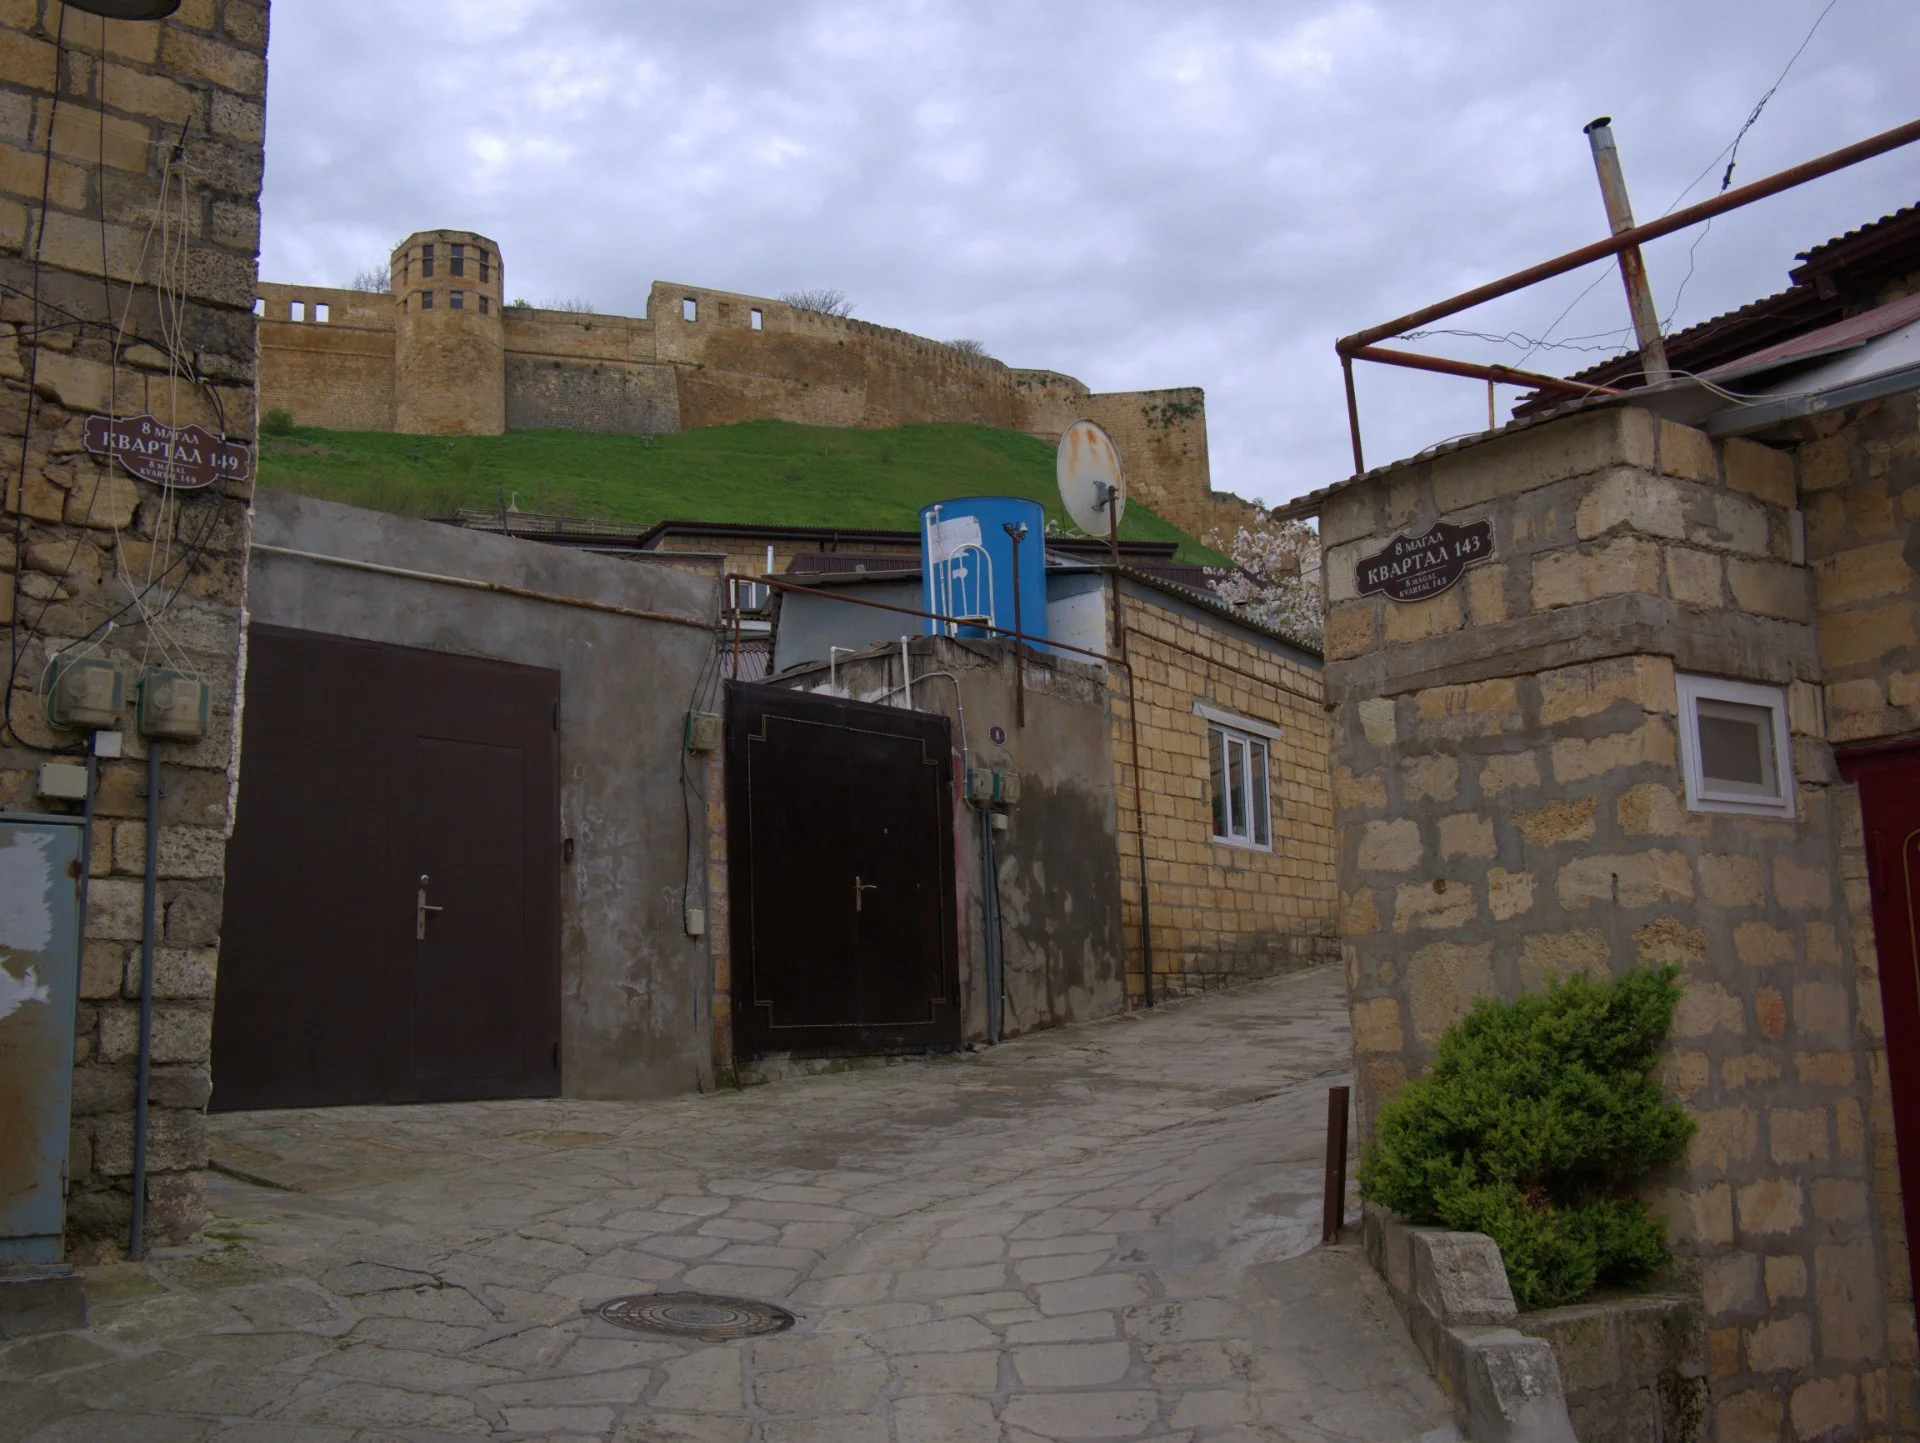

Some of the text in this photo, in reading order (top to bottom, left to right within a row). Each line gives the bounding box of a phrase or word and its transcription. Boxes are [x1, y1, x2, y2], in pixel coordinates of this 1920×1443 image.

[142, 422, 199, 444] 8 МАГАЛ
[103, 431, 239, 471] КВАРТАЛ 149
[1395, 532, 1444, 556] 8 МАГАЛ
[1367, 535, 1481, 585] КВАРТАЛ 143
[1412, 572, 1437, 585] MAGAL
[1399, 583, 1431, 598] KVARTAL
